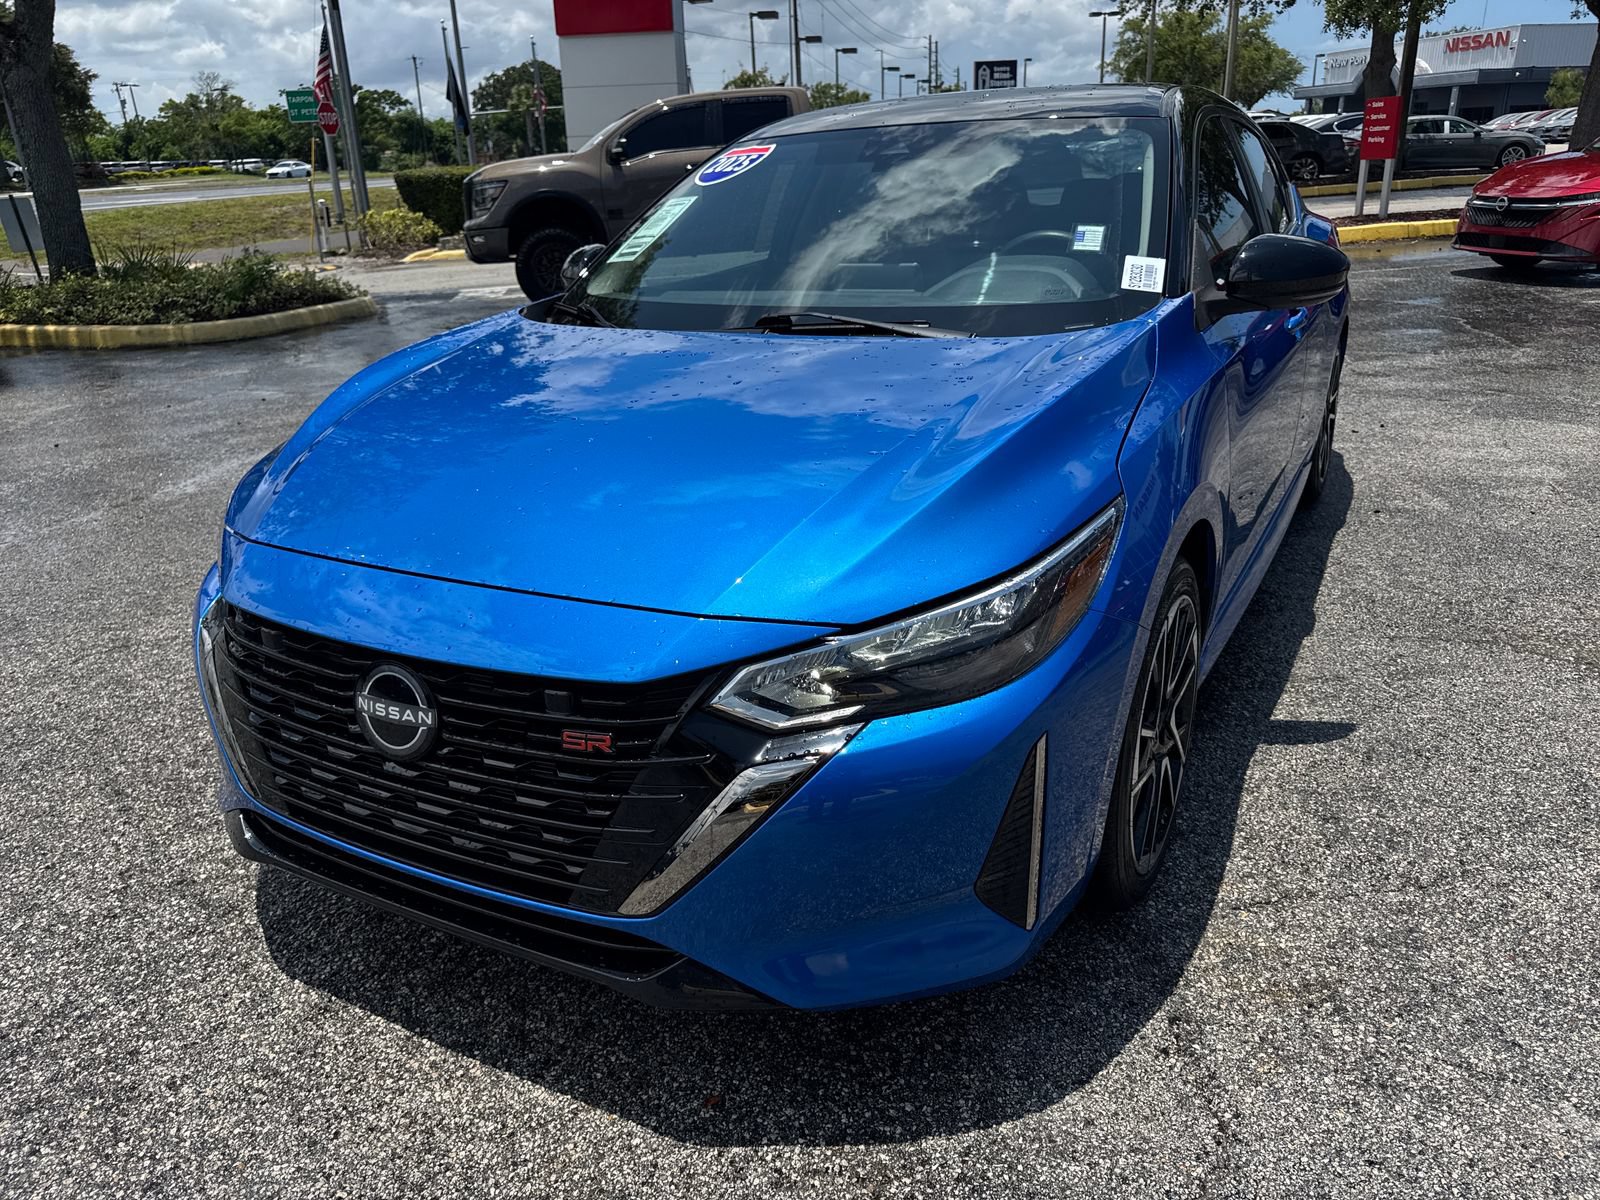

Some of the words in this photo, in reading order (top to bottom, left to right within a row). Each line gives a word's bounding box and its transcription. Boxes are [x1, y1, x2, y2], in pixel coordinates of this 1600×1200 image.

[1444, 30, 1510, 54] NISSAN
[1329, 58, 1349, 69] New
[1350, 55, 1368, 66] Port
[319, 112, 337, 125] STOP
[1367, 136, 1385, 144] Parking
[703, 154, 759, 173] 2025
[358, 696, 432, 725] NISSAN
[562, 730, 613, 753] SR
